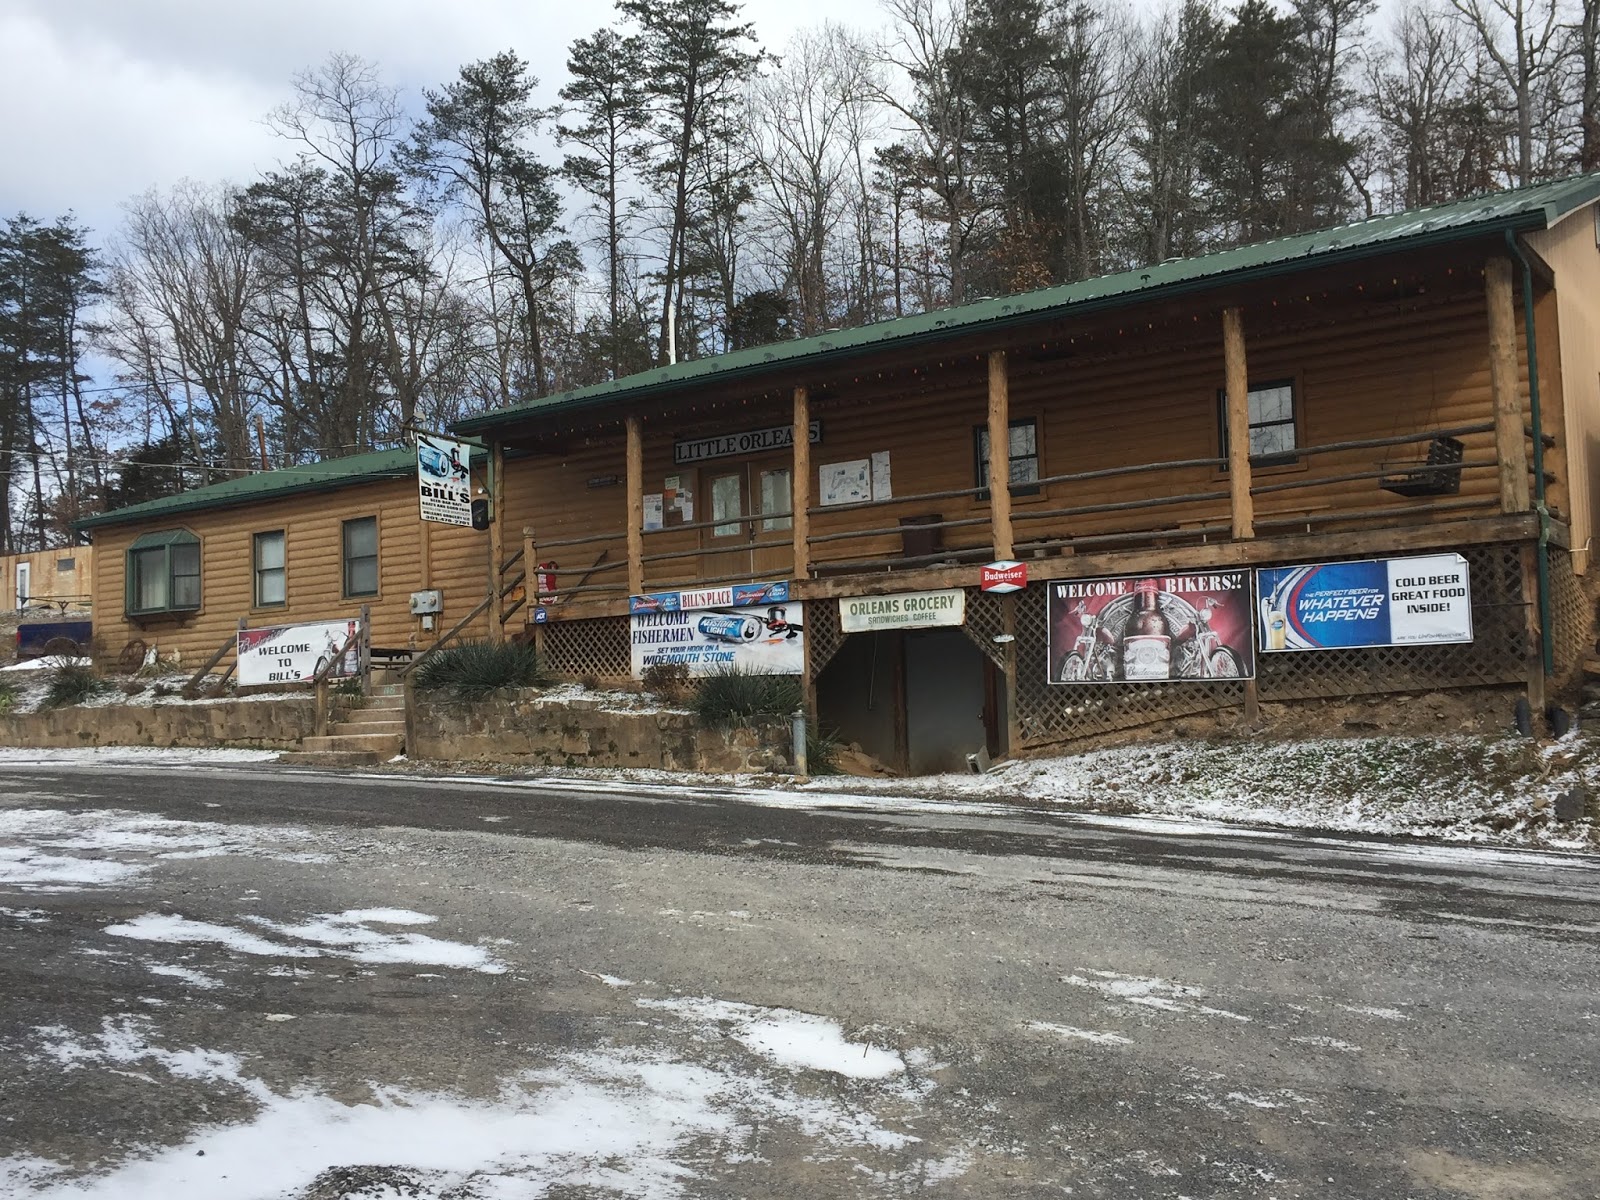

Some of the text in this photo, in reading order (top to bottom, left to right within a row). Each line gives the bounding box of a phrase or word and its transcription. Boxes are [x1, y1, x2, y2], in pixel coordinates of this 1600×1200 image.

[677, 424, 818, 460] LITTLE ORLEAS
[421, 486, 470, 503] BILL'S
[984, 570, 1023, 581] Budweiser
[1395, 574, 1460, 588] COLD BEER
[1056, 574, 1242, 599] WELCOME BIKERS!!
[1315, 589, 1349, 597] PERFECT
[1348, 587, 1368, 595] BEER
[682, 590, 732, 608] BILL'S PLACE
[1392, 587, 1466, 602] GREAT FOOD
[850, 595, 955, 616] ORLEANS GROCERY
[1299, 594, 1385, 610] WHATEVER
[1407, 602, 1451, 615] INSIDE!
[638, 611, 690, 627] WELCOME
[868, 612, 937, 625] SANDWICHES COFFEE
[1302, 607, 1380, 623] HAPPENS
[701, 618, 737, 628] KEYSTONE
[632, 627, 695, 644] FISHERMEN
[706, 626, 728, 635] LIGHT
[259, 643, 311, 656] WELCOME
[657, 646, 669, 654] SET
[278, 658, 292, 668] TO
[643, 653, 700, 665] WIDEMOUTH
[269, 670, 301, 682] BILL'S
